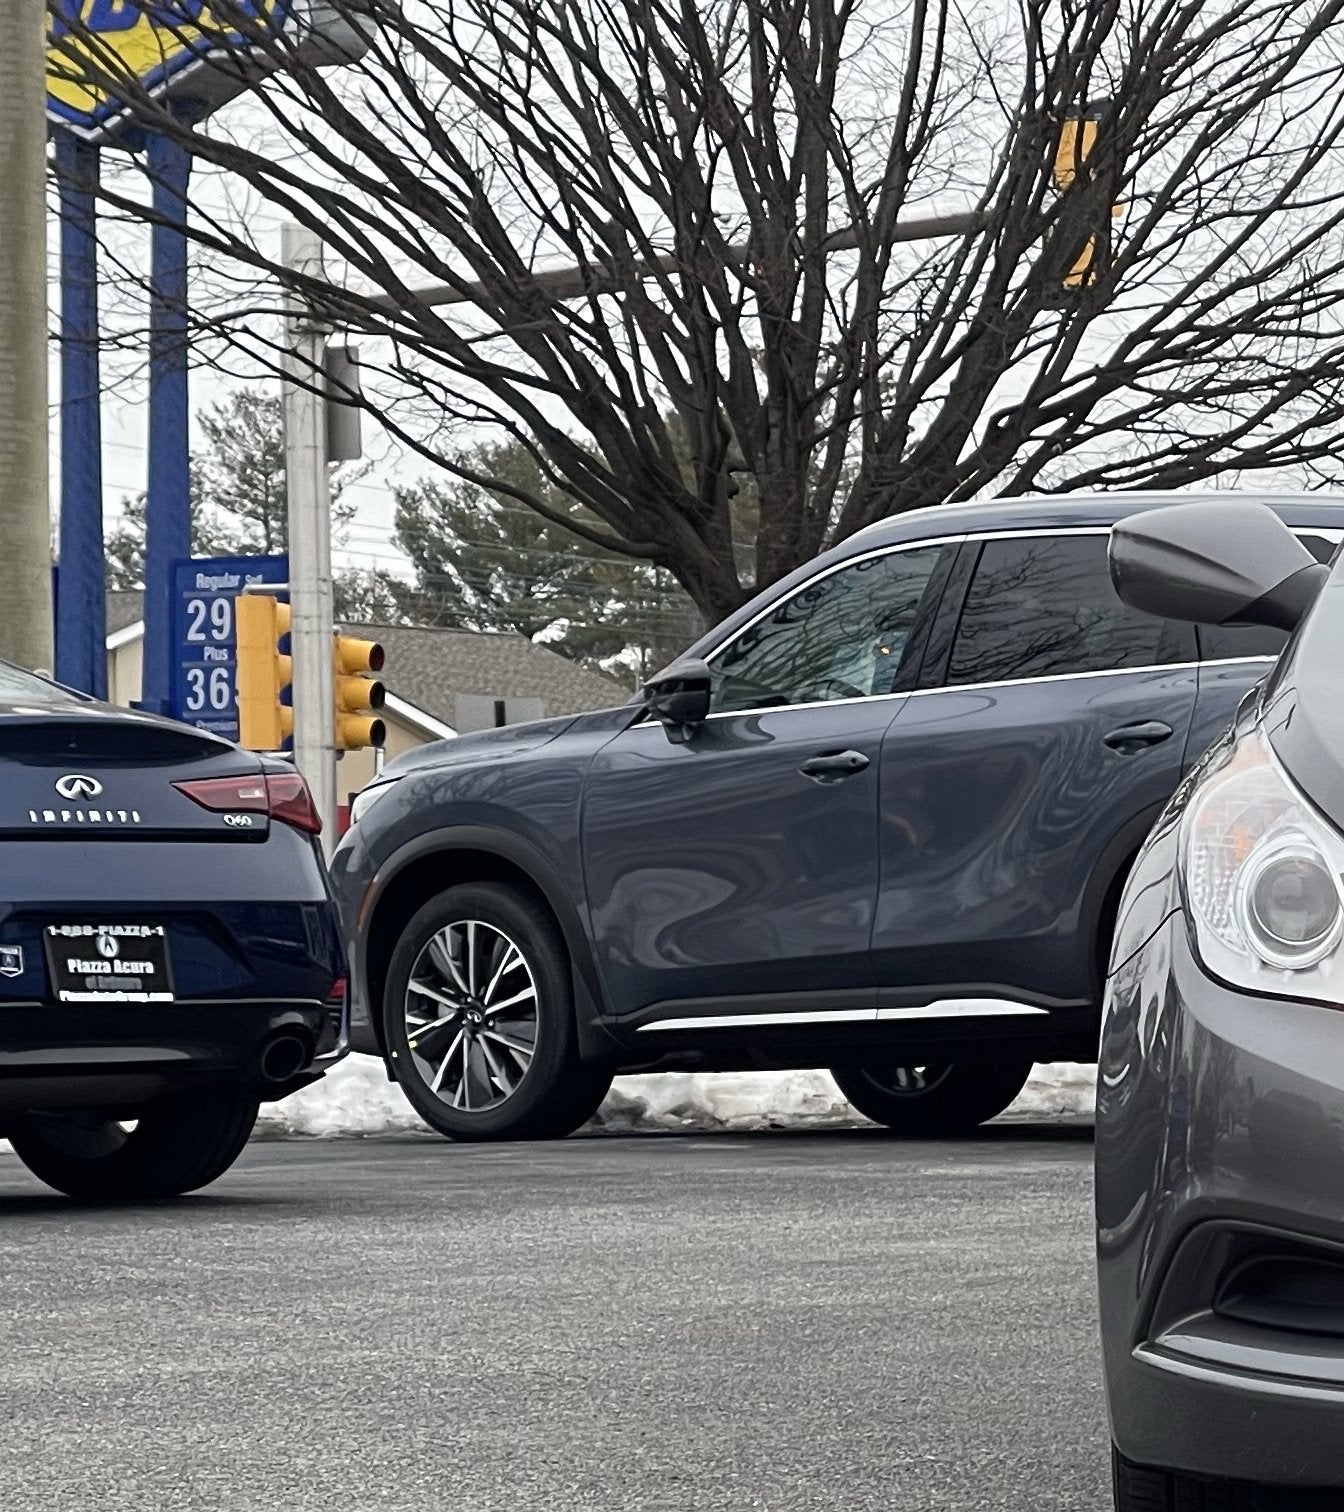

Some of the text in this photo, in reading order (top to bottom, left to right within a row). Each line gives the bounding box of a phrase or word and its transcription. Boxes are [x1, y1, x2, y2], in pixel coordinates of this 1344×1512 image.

[196, 571, 241, 591] Regular
[187, 597, 231, 641] 29
[203, 646, 229, 661] Plus
[28, 809, 140, 823] INFINITI
[223, 813, 252, 827] Q60
[67, 959, 154, 974] Piazza Acura
